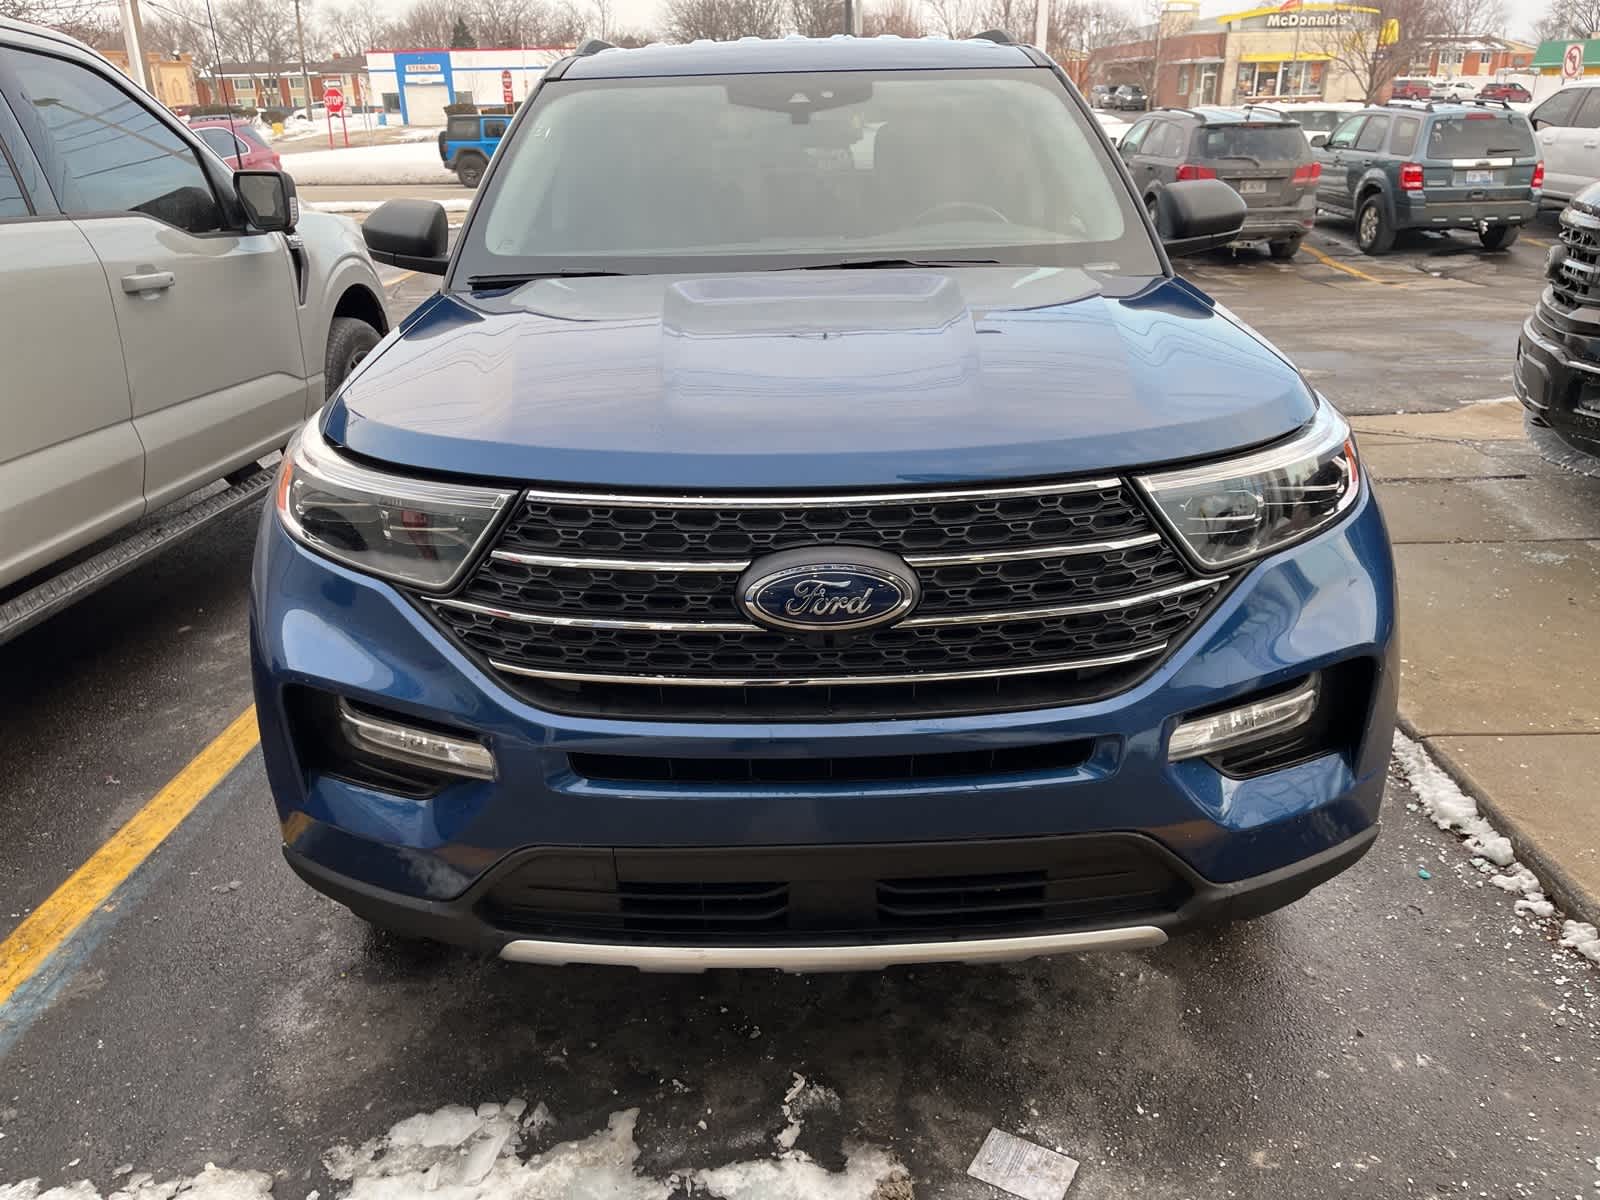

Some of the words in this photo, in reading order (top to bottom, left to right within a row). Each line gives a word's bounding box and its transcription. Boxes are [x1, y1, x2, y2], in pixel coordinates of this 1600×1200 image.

[1266, 14, 1347, 27] McDonald's
[325, 96, 343, 105] STOP
[785, 579, 874, 616] Ford
